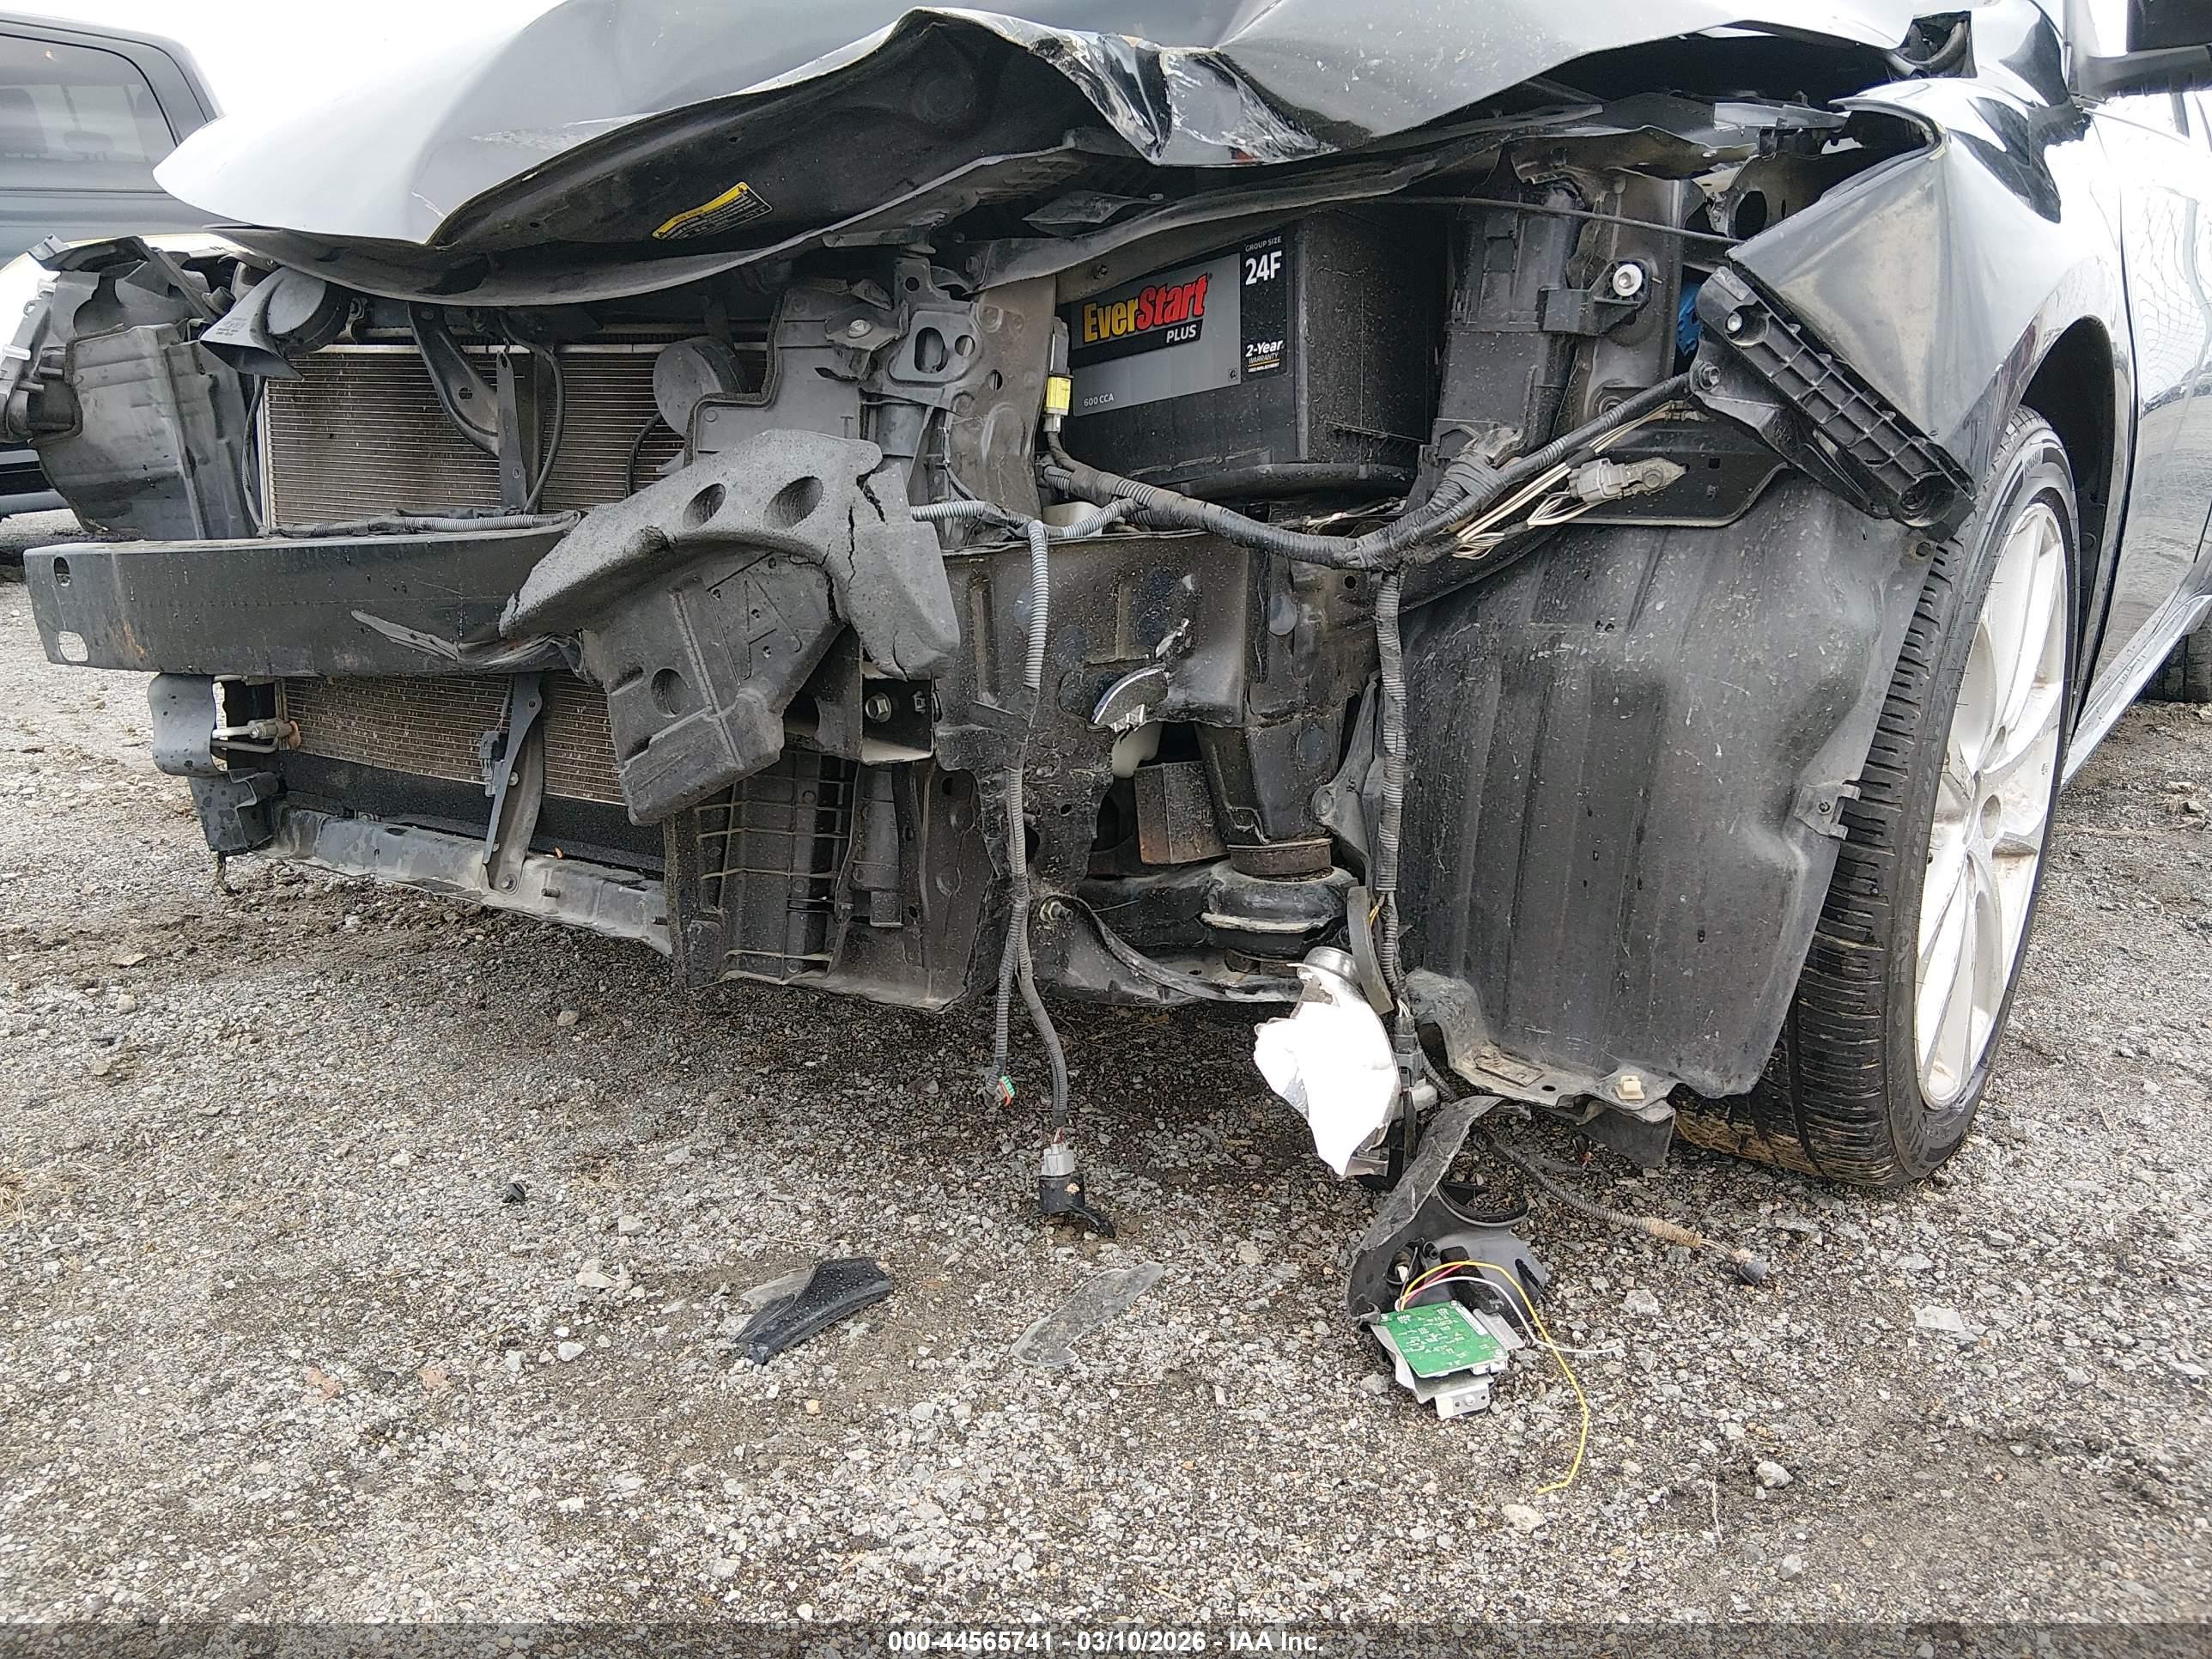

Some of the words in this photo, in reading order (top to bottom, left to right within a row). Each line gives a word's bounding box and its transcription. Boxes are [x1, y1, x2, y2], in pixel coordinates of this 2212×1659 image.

[1245, 240, 1267, 252] GROUP
[1267, 235, 1282, 246] SIZE
[1245, 250, 1282, 286] 24F
[1083, 272, 1208, 343] EverStart
[1165, 324, 1197, 343] PLUS
[1245, 340, 1284, 358] 2-Year
[1084, 397, 1099, 407] 600
[1099, 392, 1115, 404] CCA
